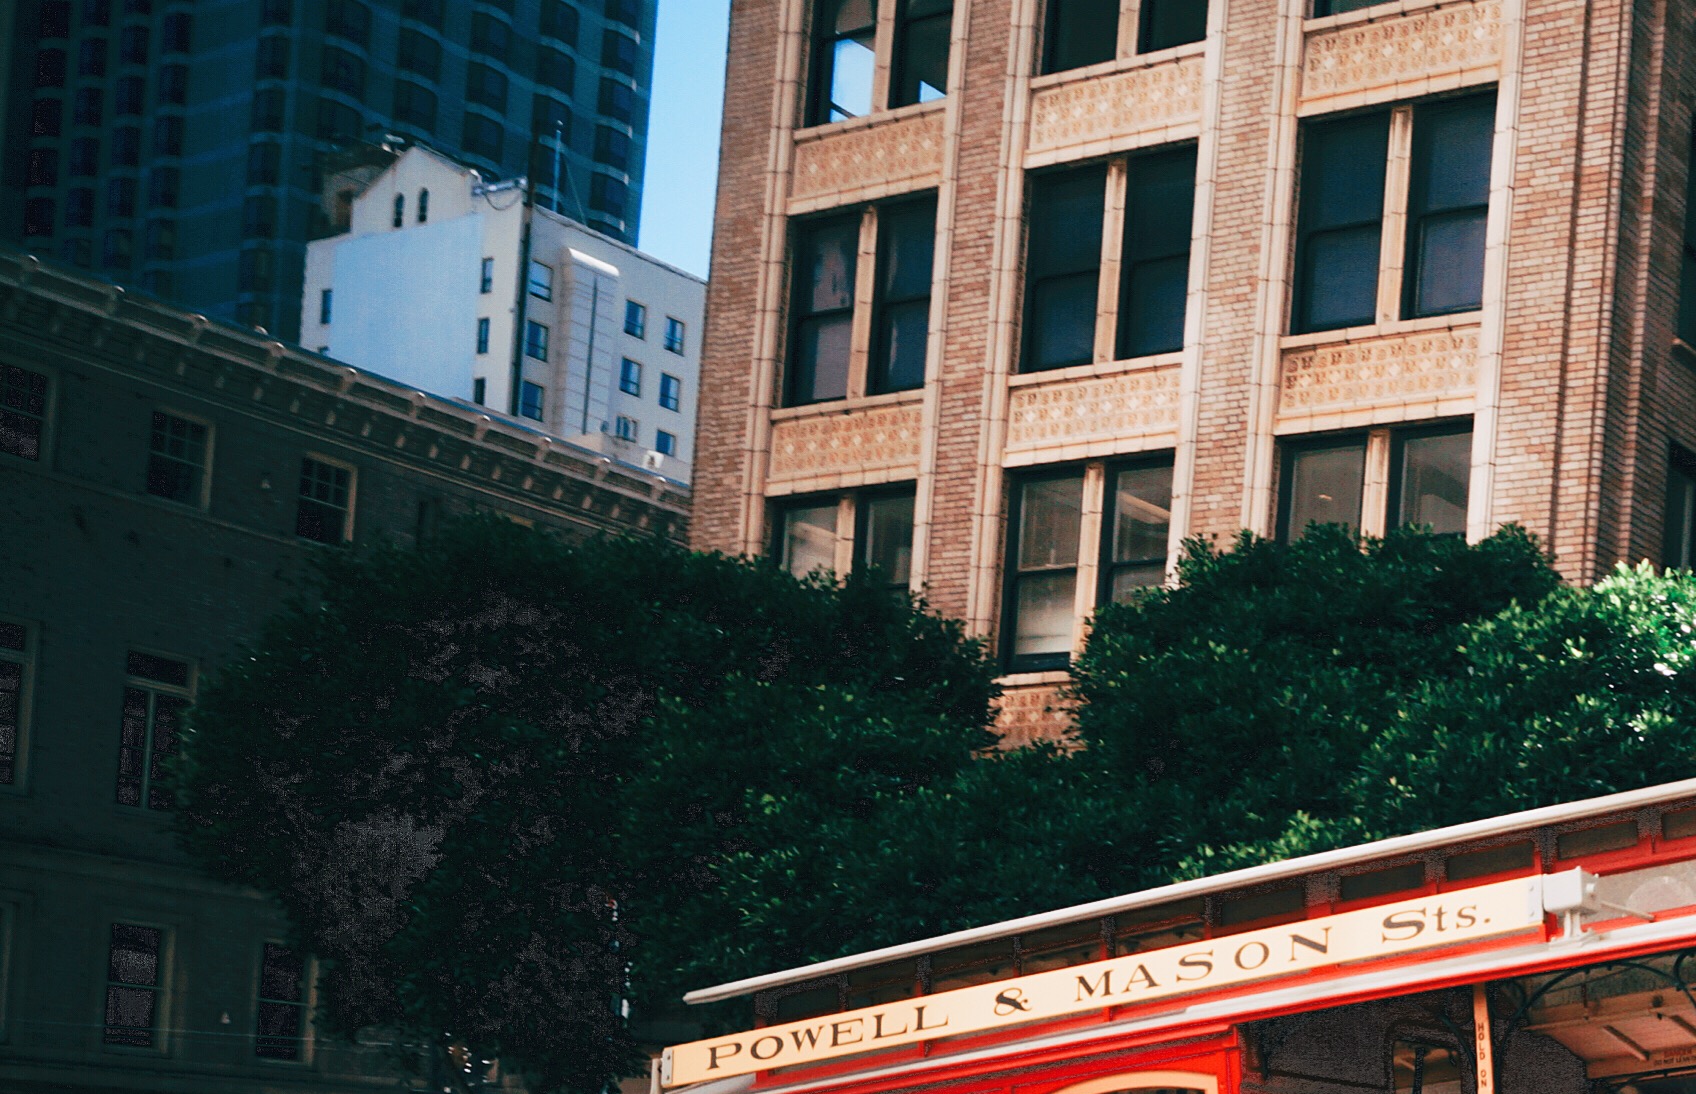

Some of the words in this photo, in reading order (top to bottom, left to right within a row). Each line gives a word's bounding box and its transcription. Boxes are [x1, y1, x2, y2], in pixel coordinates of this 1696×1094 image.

[706, 1005, 950, 1071] POWELL
[992, 987, 1032, 1017] &
[1074, 926, 1332, 1002] MASON
[1381, 904, 1492, 943] Sts.
[1478, 1023, 1487, 1061] HOLD
[1480, 1069, 1488, 1088] ON
